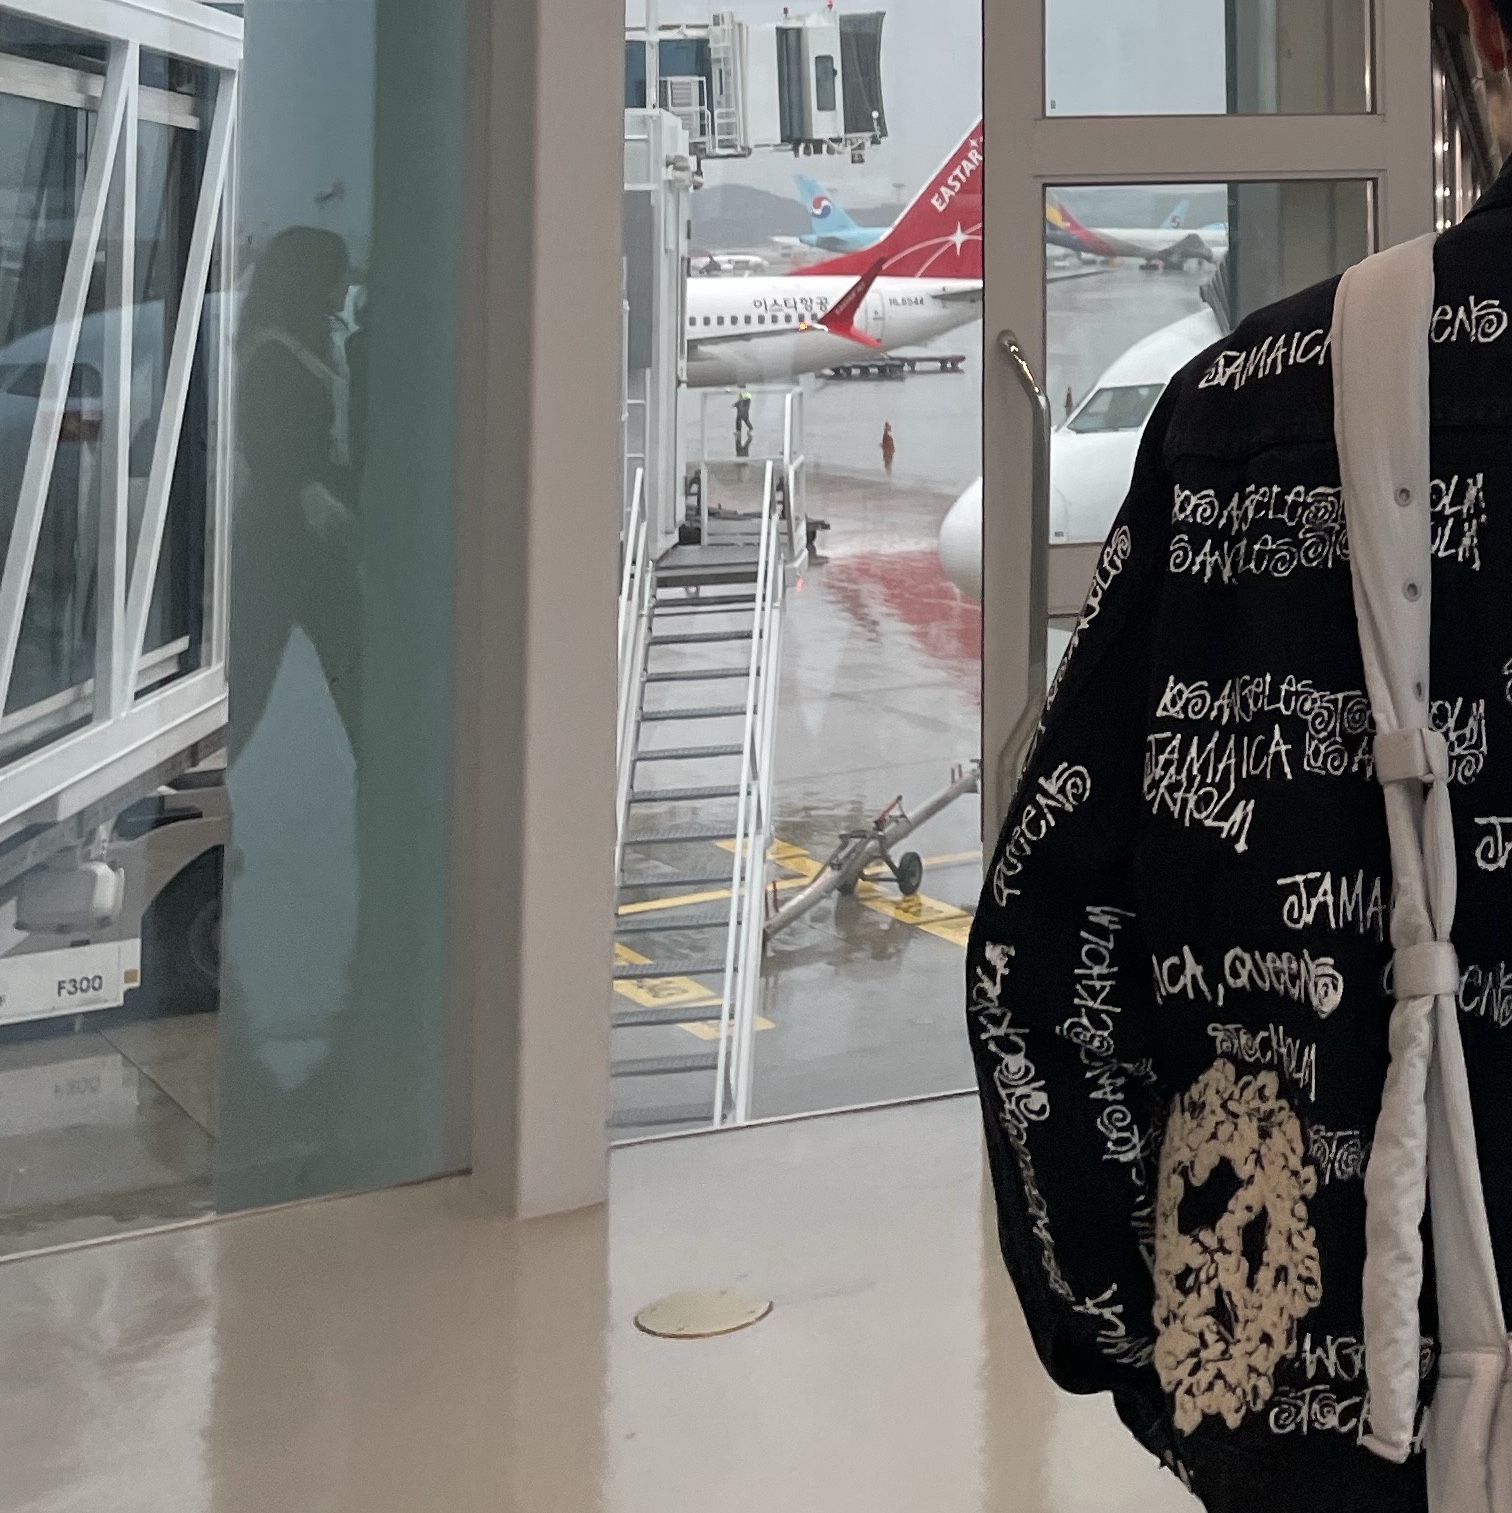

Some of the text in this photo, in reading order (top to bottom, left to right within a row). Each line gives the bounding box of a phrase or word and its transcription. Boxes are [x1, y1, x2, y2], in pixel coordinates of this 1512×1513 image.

[930, 148, 984, 213] EASTAR
[753, 296, 830, 315] 이스타항공
[57, 974, 104, 998] F300
